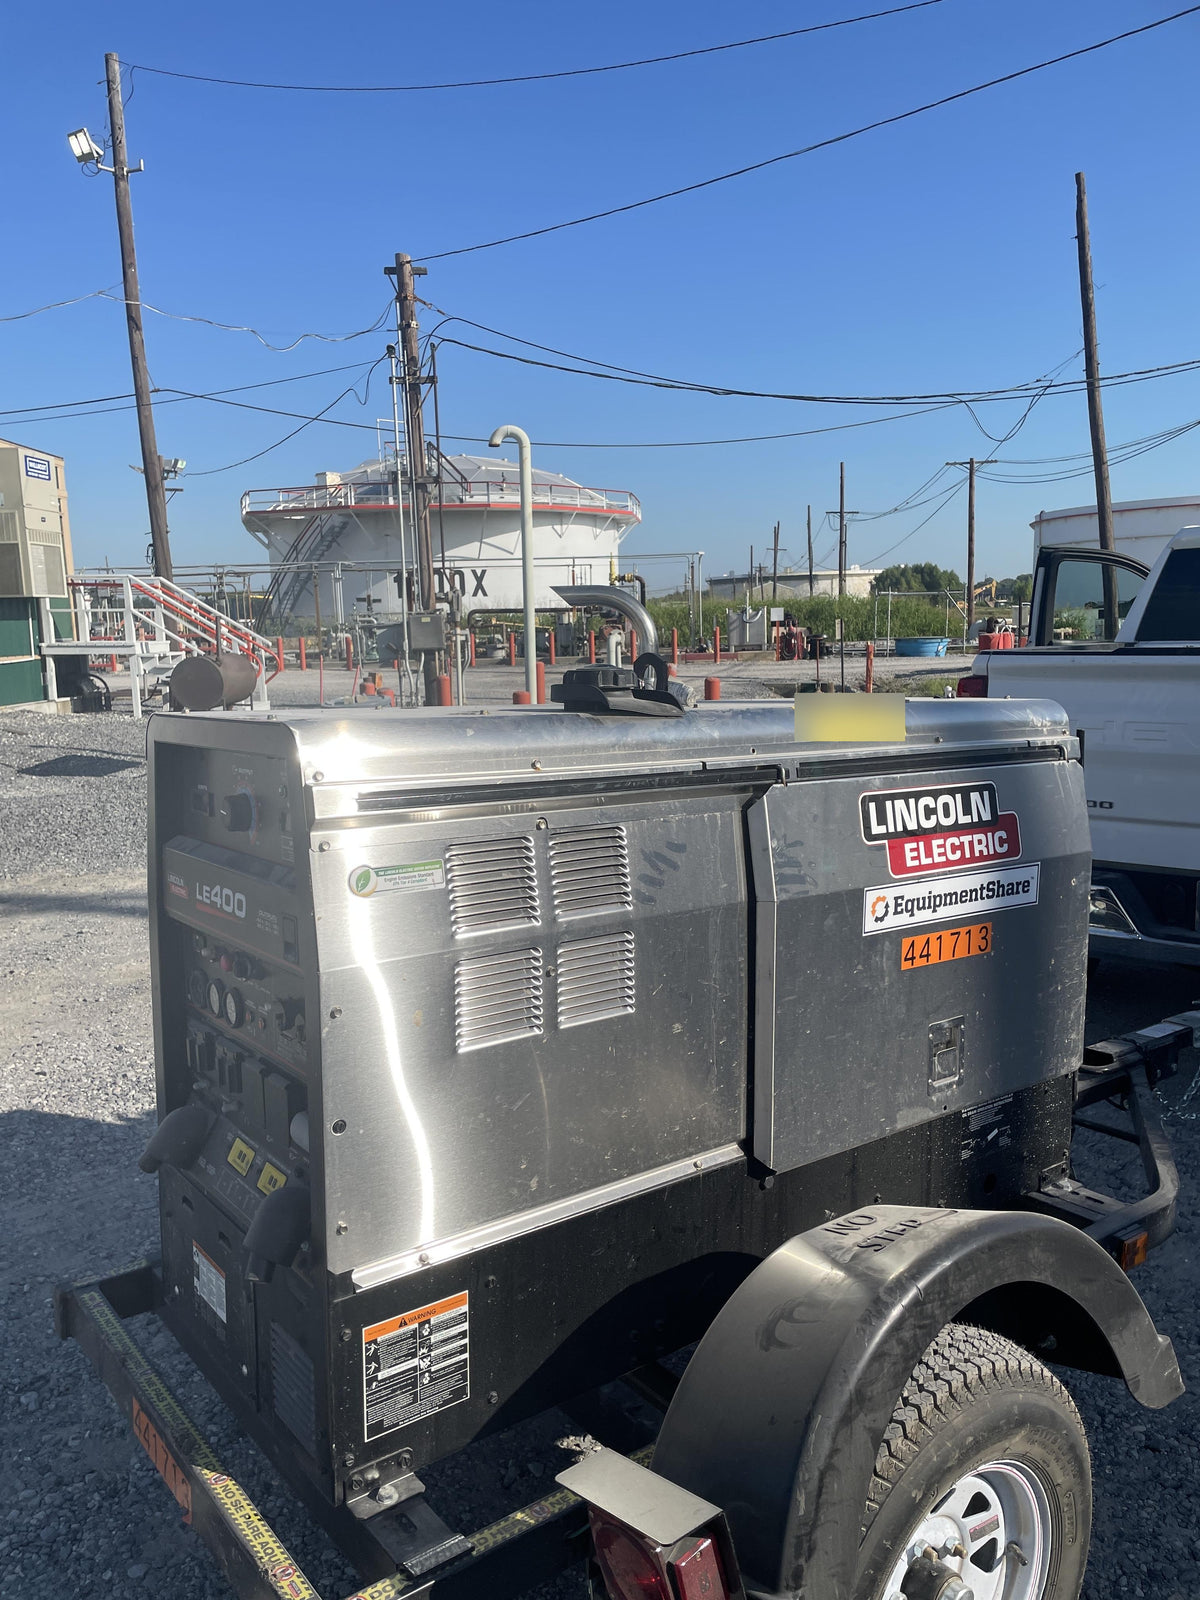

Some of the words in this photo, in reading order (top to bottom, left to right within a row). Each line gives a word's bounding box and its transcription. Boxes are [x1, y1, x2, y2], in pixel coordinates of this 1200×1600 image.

[868, 790, 992, 836] LINCOLN
[904, 830, 1008, 868] ELECTRIC
[196, 882, 246, 919] LE400
[893, 878, 1031, 916] EquipmentShare
[904, 925, 990, 966] 441713
[824, 1214, 877, 1236] NO
[856, 1219, 922, 1252] STEP
[408, 1308, 437, 1324] WARNING
[151, 1388, 167, 1402] PAS
[218, 1483, 236, 1499] NO
[229, 1498, 246, 1514] SE
[238, 1512, 264, 1540] PARE
[549, 1494, 570, 1508] NE
[368, 1581, 396, 1600] DO
